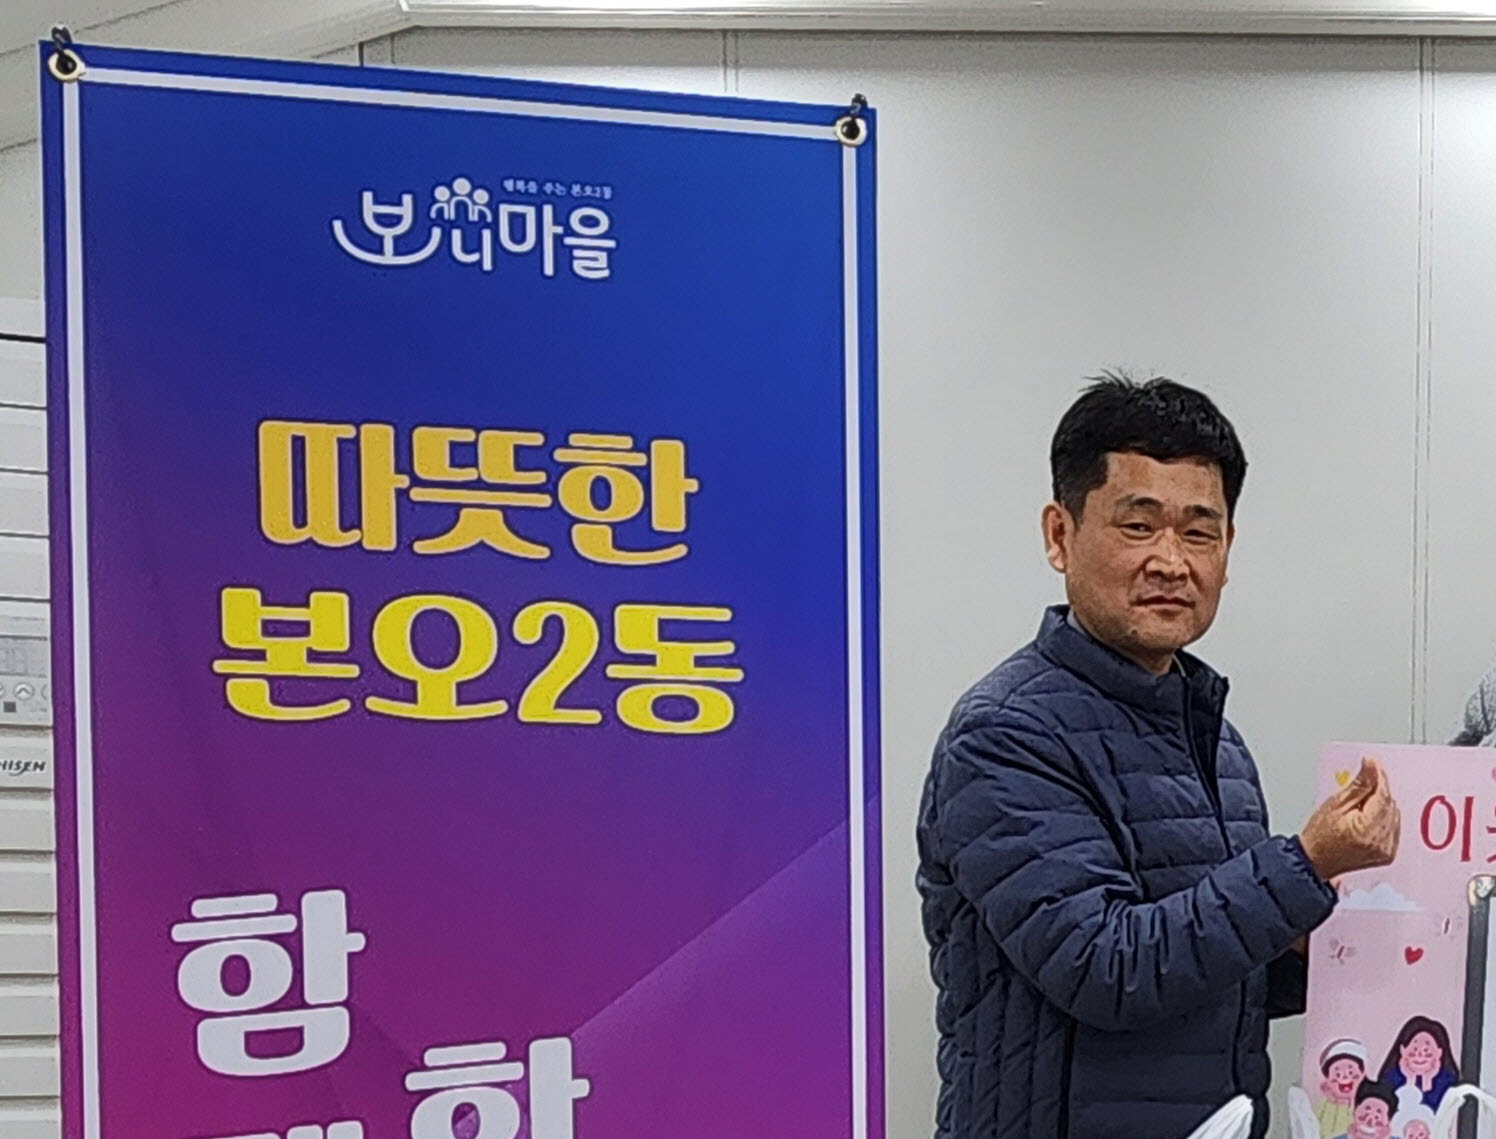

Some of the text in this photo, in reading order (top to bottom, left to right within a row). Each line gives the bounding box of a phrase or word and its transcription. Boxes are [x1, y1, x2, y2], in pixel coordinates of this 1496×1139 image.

[332, 190, 617, 279] 보니마을
[259, 420, 699, 565] 따뜻한
[213, 588, 744, 735] 본오2동
